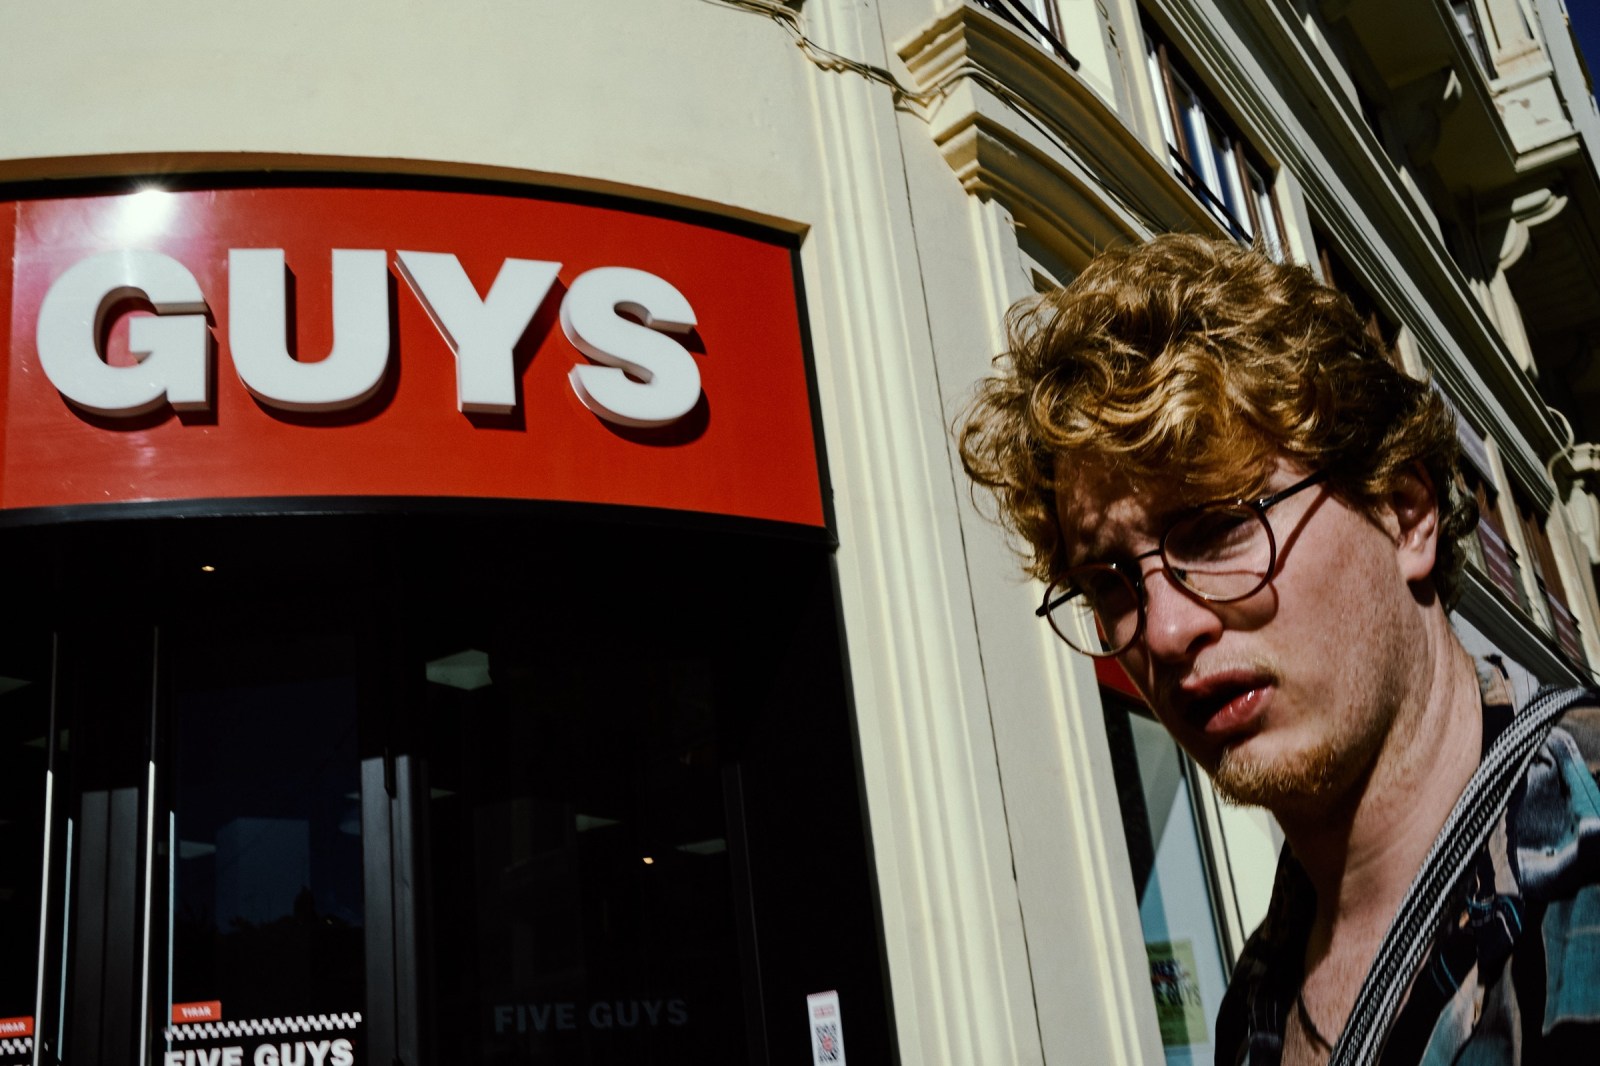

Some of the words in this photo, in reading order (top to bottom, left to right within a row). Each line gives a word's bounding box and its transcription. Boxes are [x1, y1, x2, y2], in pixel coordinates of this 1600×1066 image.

[36, 248, 703, 427] GUYS
[494, 1003, 576, 1033] FIVE
[588, 999, 689, 1030] GUYS
[164, 1046, 244, 1066] FIVE
[253, 1038, 355, 1066] GUYS
